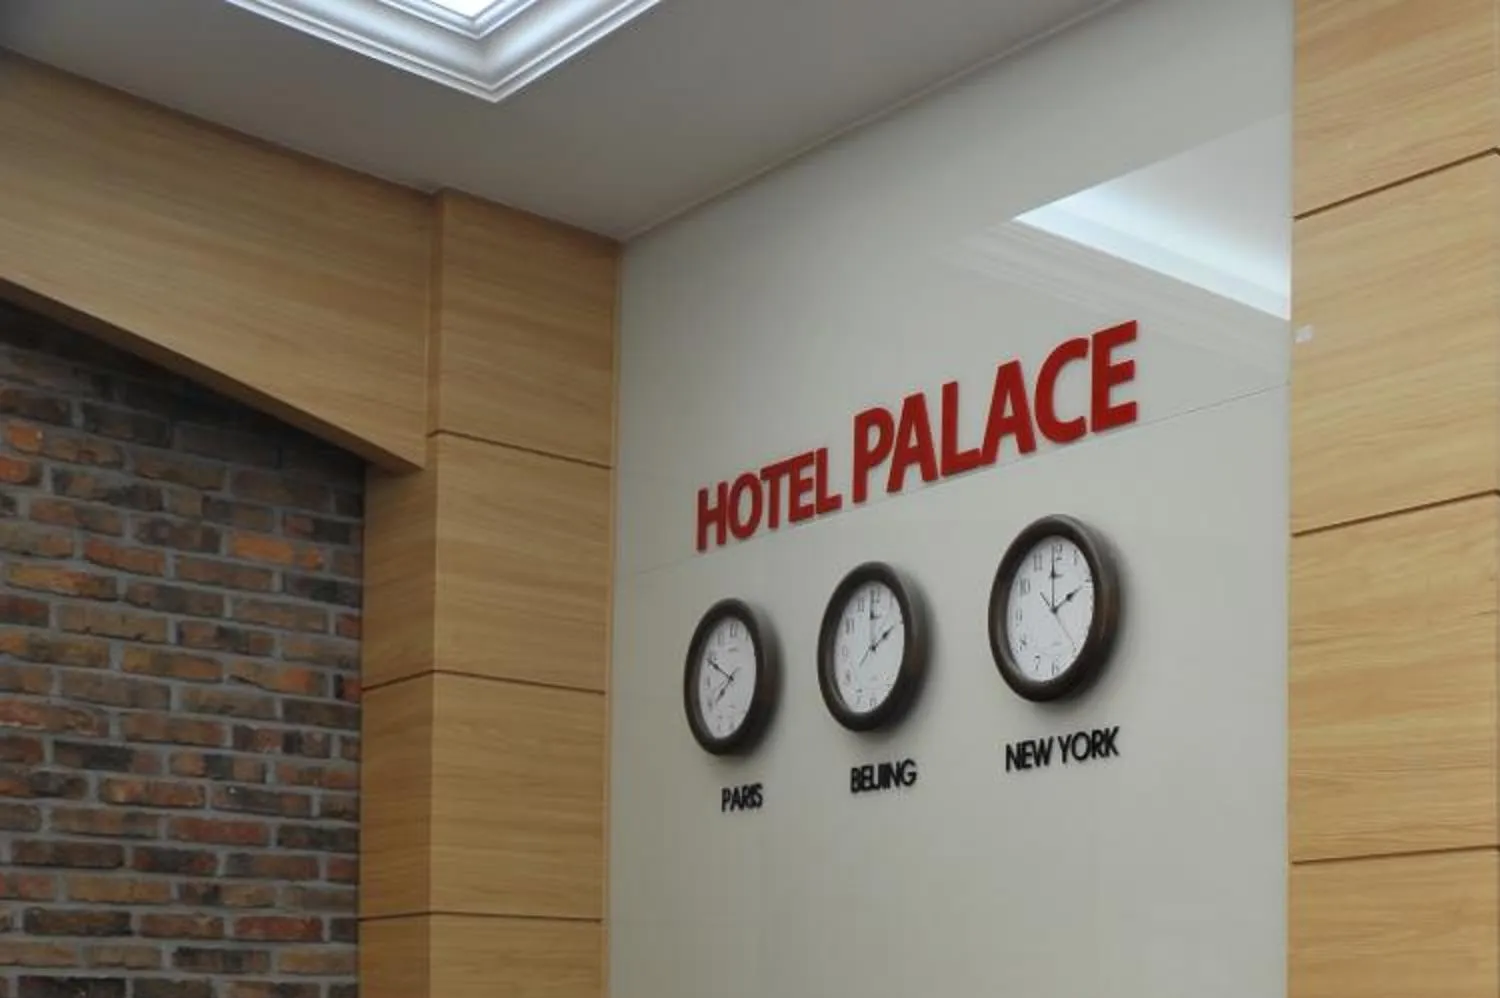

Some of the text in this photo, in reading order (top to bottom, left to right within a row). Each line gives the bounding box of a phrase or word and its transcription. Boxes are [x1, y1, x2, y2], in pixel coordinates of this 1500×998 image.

[697, 319, 1138, 552] HOTEL PALACE
[1005, 725, 1120, 773] NEW YORK
[720, 781, 764, 813] PARIS
